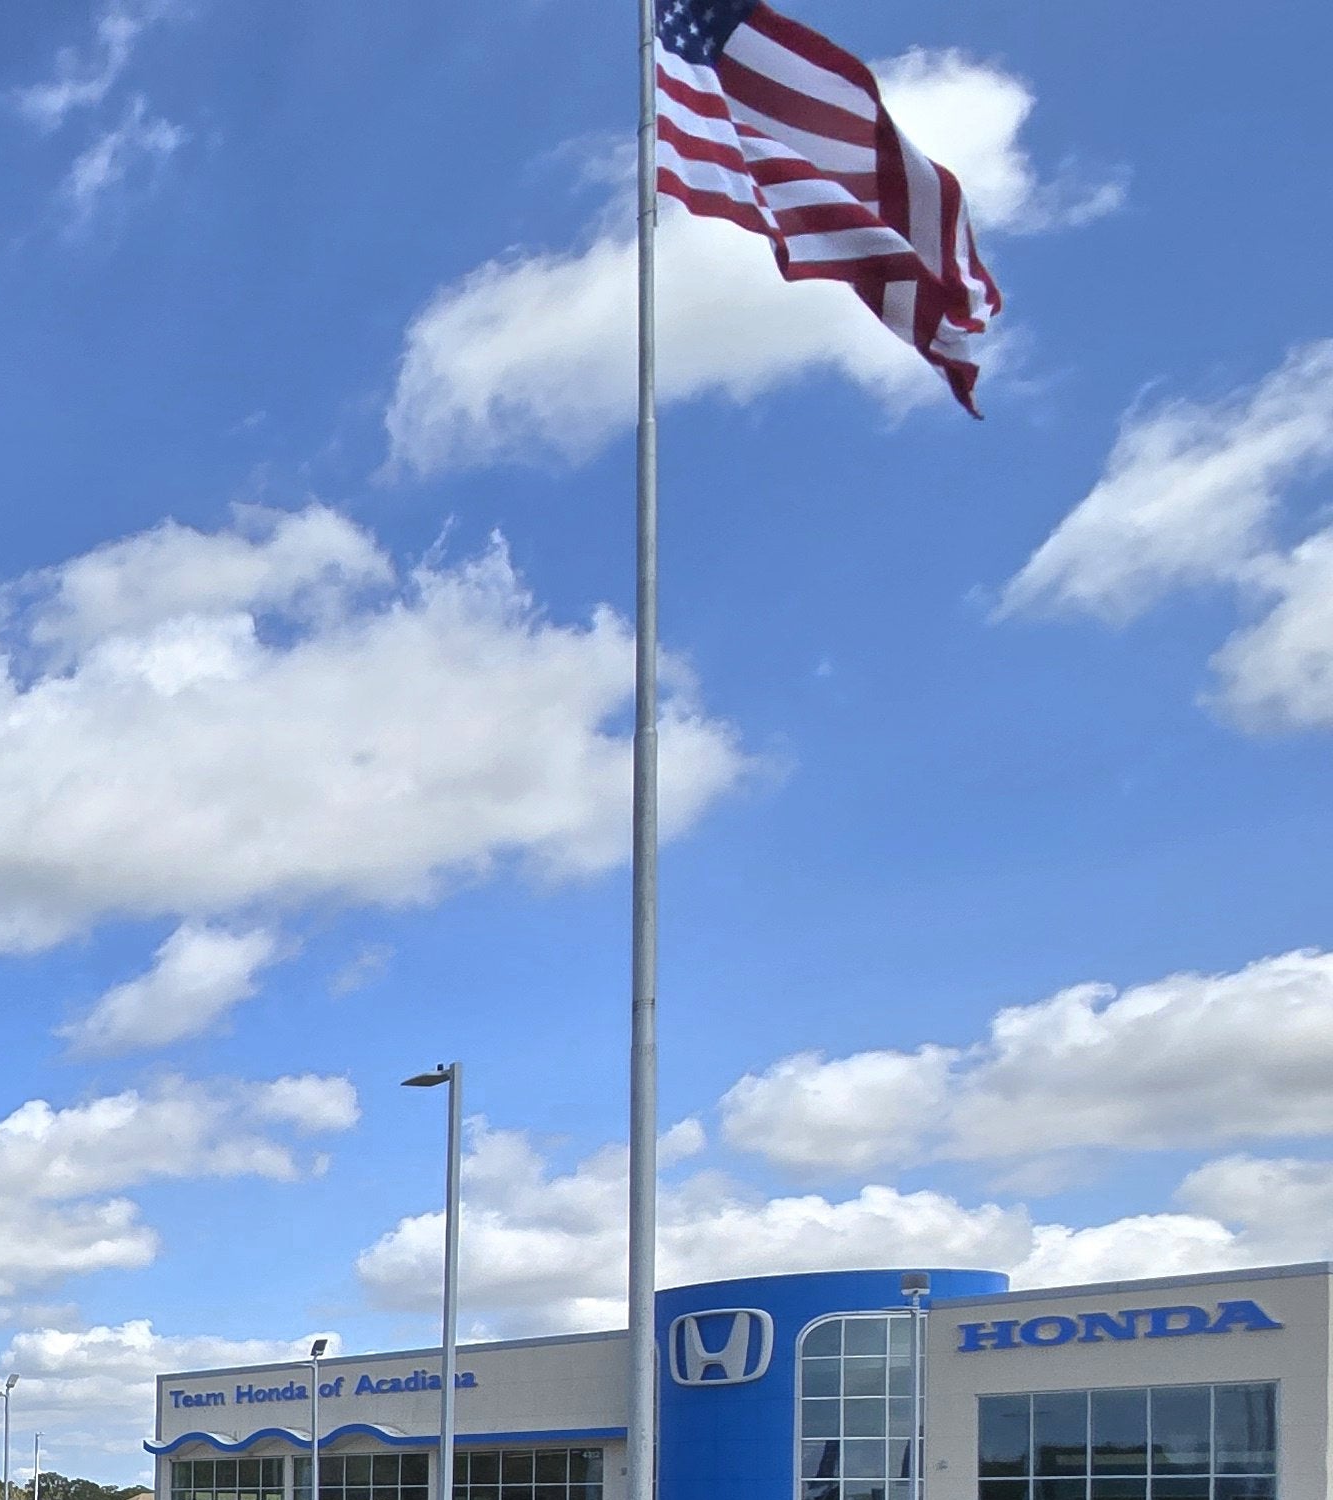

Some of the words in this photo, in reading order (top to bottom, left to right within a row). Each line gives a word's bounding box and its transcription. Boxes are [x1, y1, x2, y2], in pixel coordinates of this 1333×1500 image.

[956, 1299, 1284, 1353] HONDA
[169, 1389, 226, 1409] Team
[235, 1380, 309, 1404] Honda
[318, 1376, 345, 1398] of
